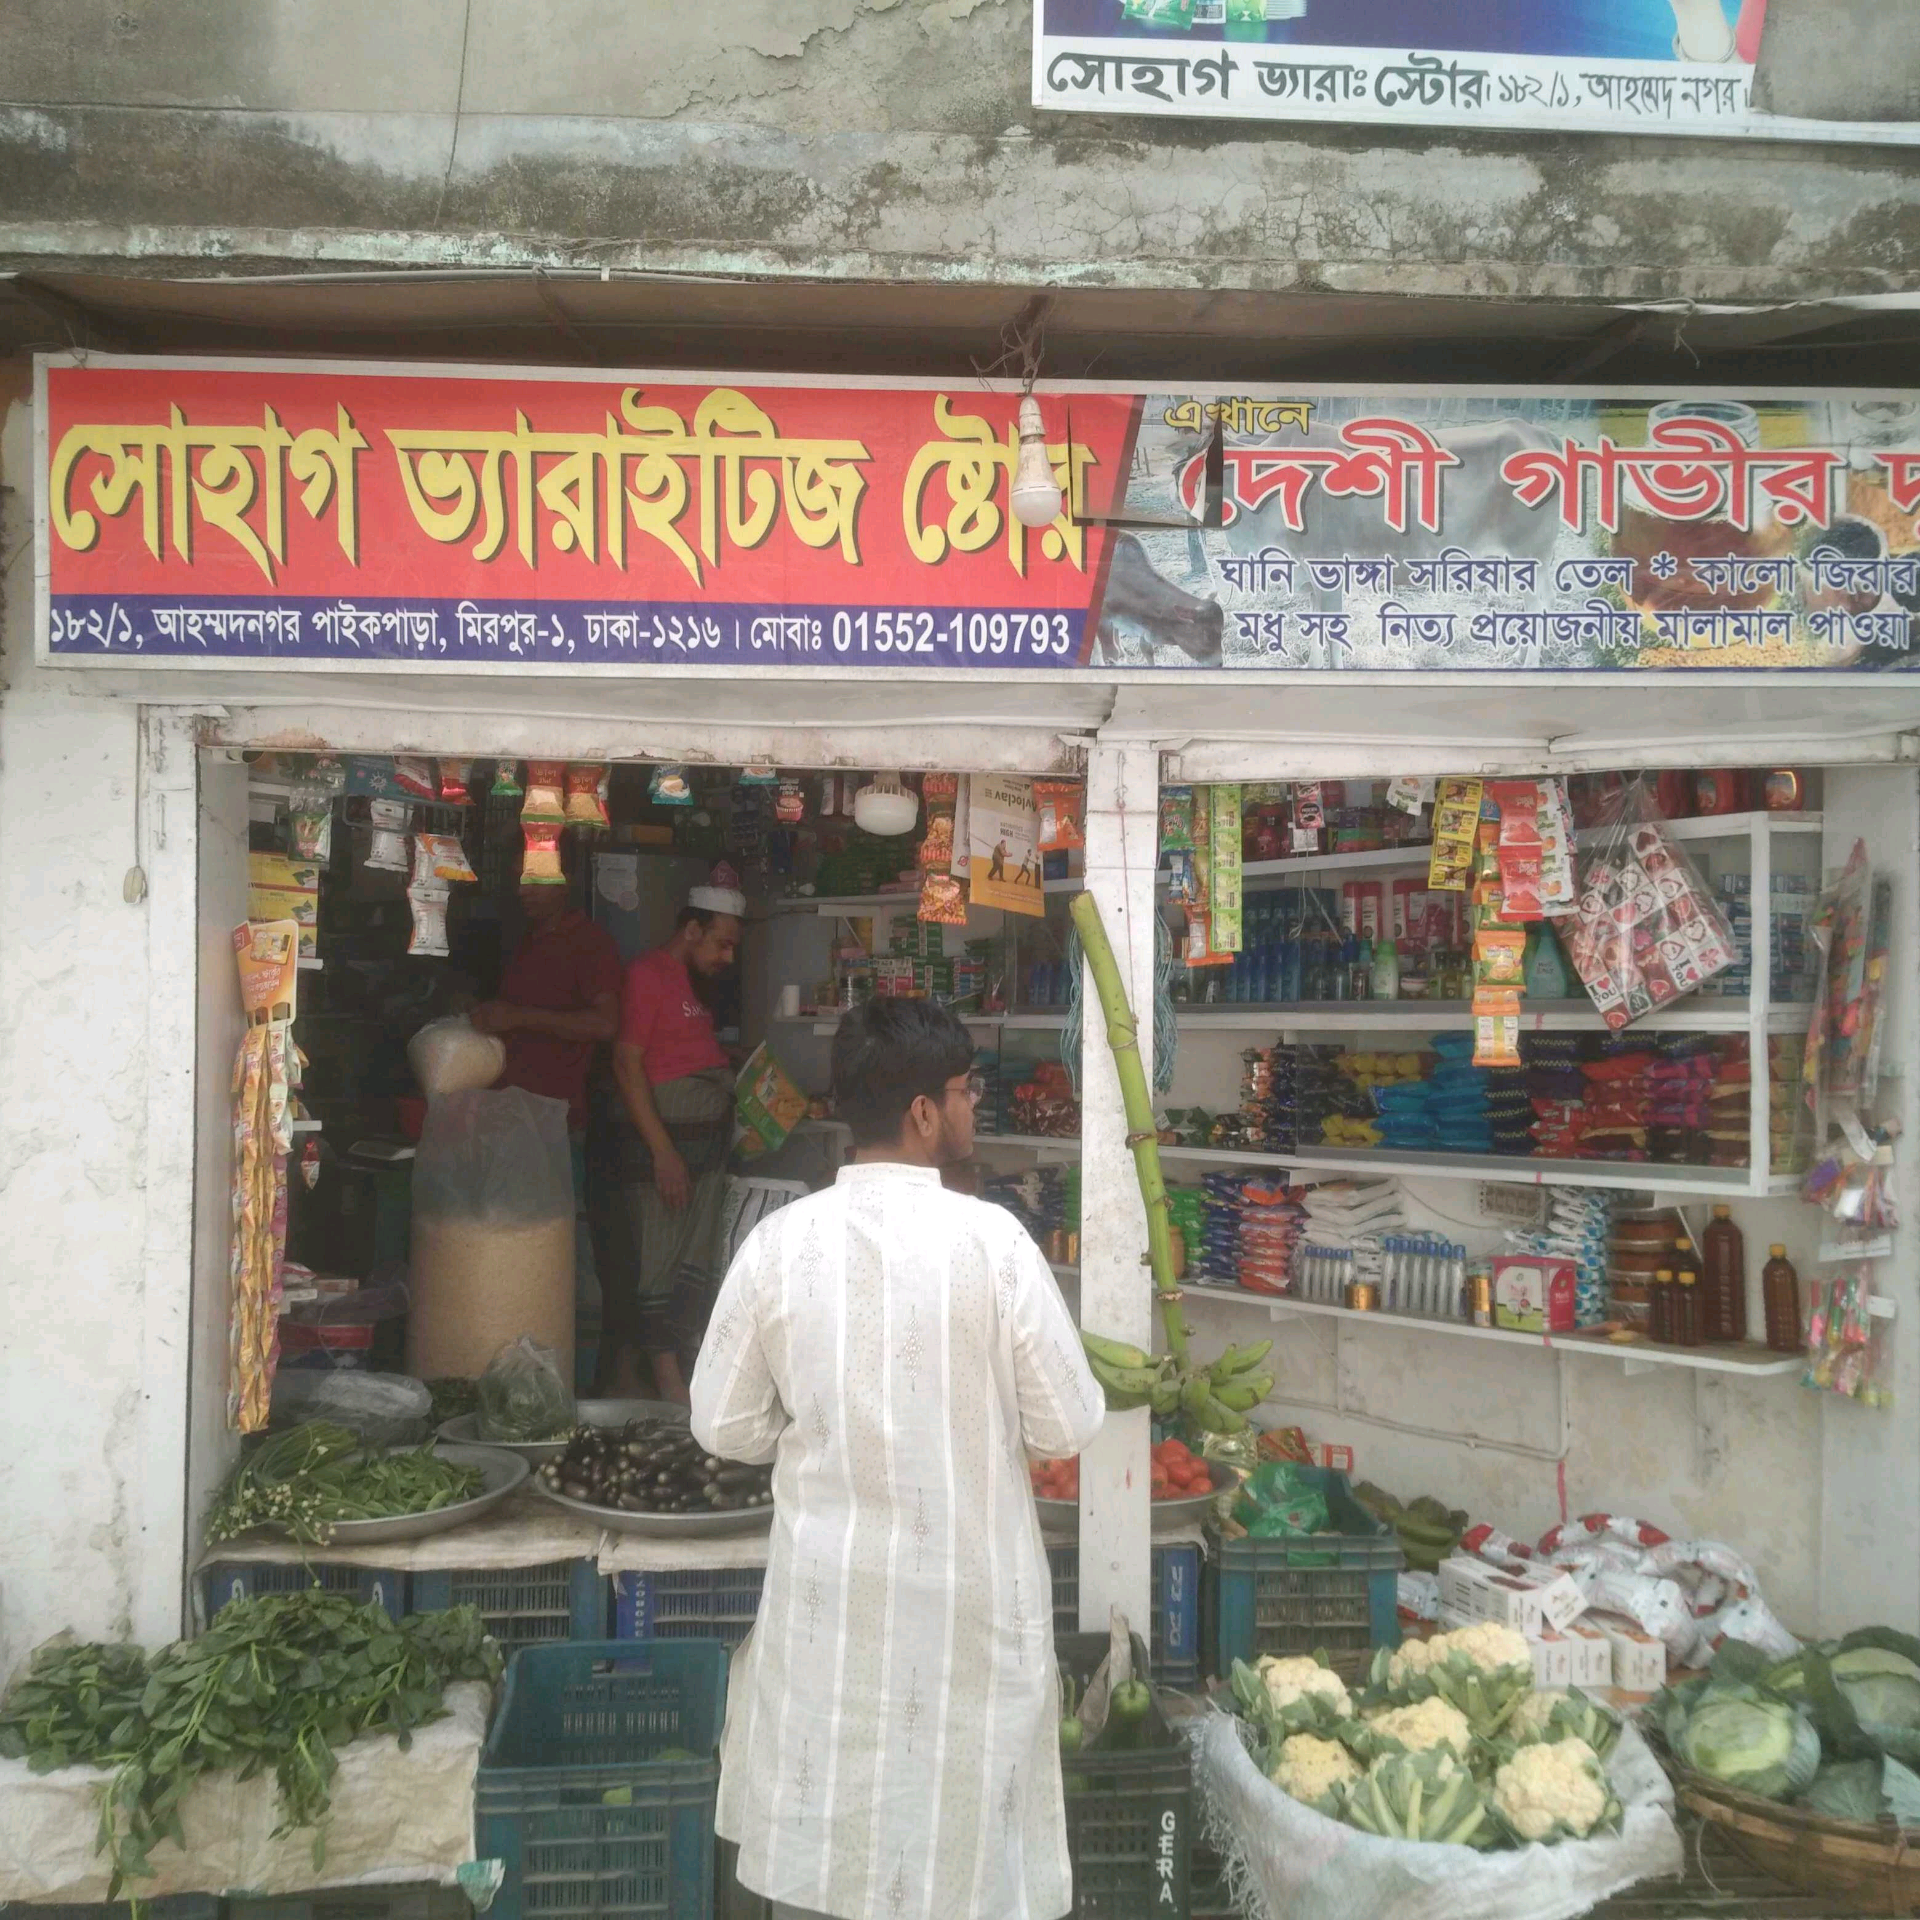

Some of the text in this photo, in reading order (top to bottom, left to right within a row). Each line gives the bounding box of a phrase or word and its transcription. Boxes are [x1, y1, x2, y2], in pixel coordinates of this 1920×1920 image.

[1047, 48, 1239, 102] সোহাগ
[1164, 397, 1315, 434] এখানে
[49, 402, 370, 587] সোহাগ
[383, 387, 873, 589] ভ্যারাইটিজ
[1179, 416, 1460, 533] দেশী
[1500, 415, 1846, 533] গাভীর
[1215, 545, 1919, 595] ঘানি ভাঙ্গা সরিষার তেল কালো জিরার
[50, 602, 143, 649] ১৮২/১,
[151, 604, 301, 647] আহম্মদনগর
[312, 599, 447, 652] পাইকপাড়া,
[455, 600, 575, 655] মিরপুর-১,
[832, 611, 1070, 654] 01552-109793
[1234, 598, 1911, 656] মধু সহ নিত্য প্রয়োজনীয় মালামাল পাওয়া
